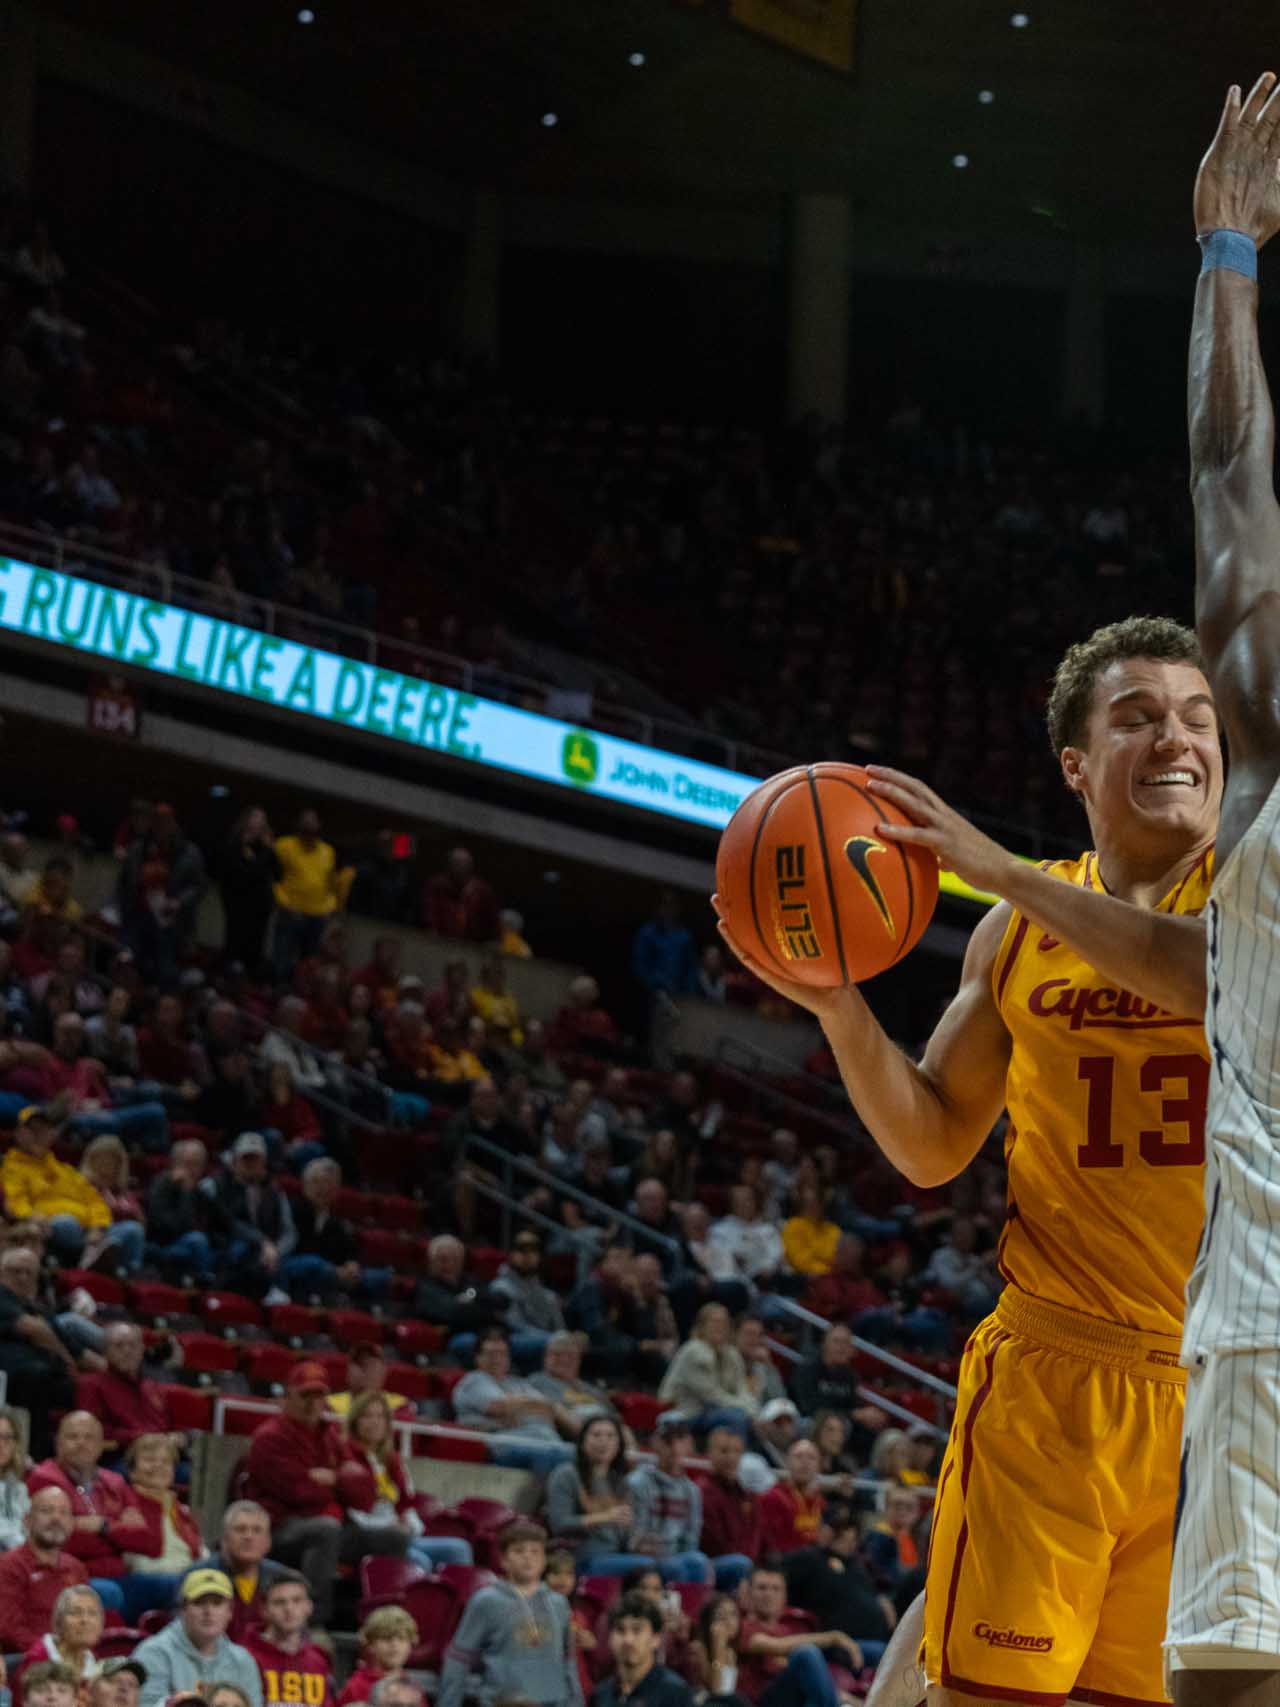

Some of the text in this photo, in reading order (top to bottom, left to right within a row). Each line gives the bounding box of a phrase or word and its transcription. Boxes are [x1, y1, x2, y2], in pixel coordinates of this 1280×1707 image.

[22, 566, 166, 664] RUNS
[173, 612, 284, 701] LIKE
[285, 648, 317, 714] A
[774, 844, 823, 960] ELITE
[1077, 1055, 1211, 1168] 13
[265, 1669, 326, 1705] ISU
[974, 1622, 1054, 1650] Cyclones
